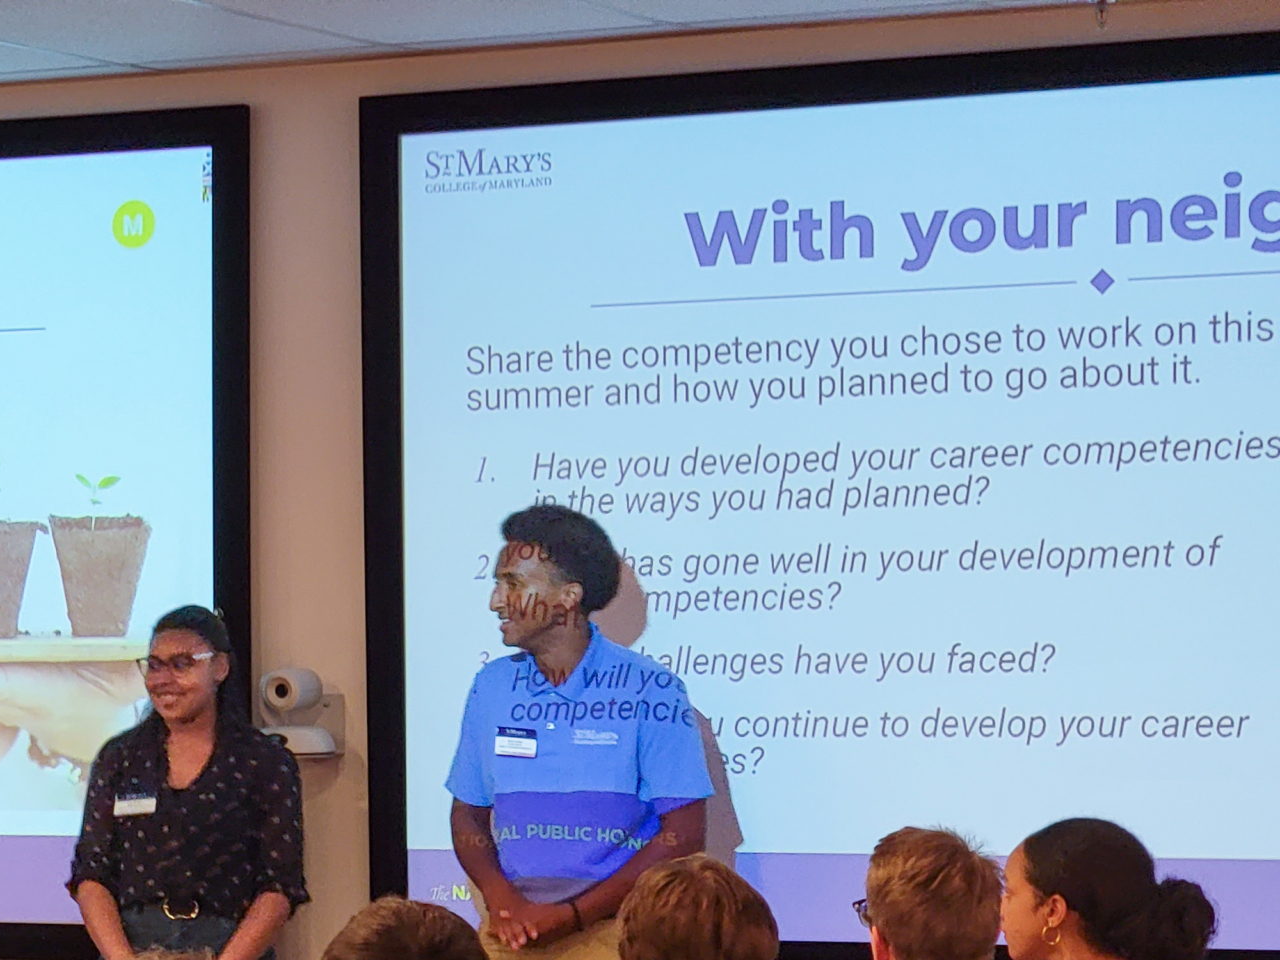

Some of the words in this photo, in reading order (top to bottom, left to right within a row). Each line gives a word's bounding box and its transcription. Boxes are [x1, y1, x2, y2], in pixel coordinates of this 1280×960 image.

[424, 182, 478, 194] COLLEGE
[488, 177, 552, 190] MARYLAND
[684, 198, 875, 269] With
[900, 199, 1088, 272] your
[466, 343, 554, 376] Share
[561, 339, 612, 372] the
[622, 335, 821, 374] competency
[829, 334, 889, 369] you
[900, 324, 1003, 358] chose
[1011, 323, 1046, 353] to
[1057, 315, 1143, 351] work
[1153, 321, 1197, 347] on
[1208, 309, 1275, 345] this
[466, 384, 595, 412] summer
[604, 372, 661, 407] and
[673, 371, 740, 404] how
[748, 375, 806, 410] you
[818, 361, 949, 406] planned
[959, 363, 994, 394] to
[1005, 366, 1048, 400] go
[1059, 355, 1160, 390] about
[1172, 354, 1201, 385] it.
[474, 455, 496, 484] 1.
[532, 451, 607, 482] Have
[615, 454, 671, 488] you
[680, 440, 841, 484] developed
[847, 446, 921, 481] your
[929, 443, 1034, 470] career
[567, 485, 616, 515] the
[624, 489, 701, 522] ways
[708, 489, 767, 521] you
[775, 478, 835, 512] had
[841, 475, 991, 518] planned?
[682, 551, 760, 584] gone
[769, 542, 833, 575] well
[839, 543, 868, 574] in
[875, 546, 950, 582] your
[958, 537, 1176, 578] development
[1185, 534, 1224, 568] of
[582, 662, 632, 690] will
[793, 644, 869, 676] have
[875, 650, 937, 683] you
[946, 641, 1057, 675] faced?
[733, 710, 870, 739] continue
[879, 711, 911, 739] to
[919, 706, 1048, 747] develop
[1055, 714, 1133, 748] your
[1140, 714, 1251, 739] career
[525, 823, 593, 842] PUBLIC
